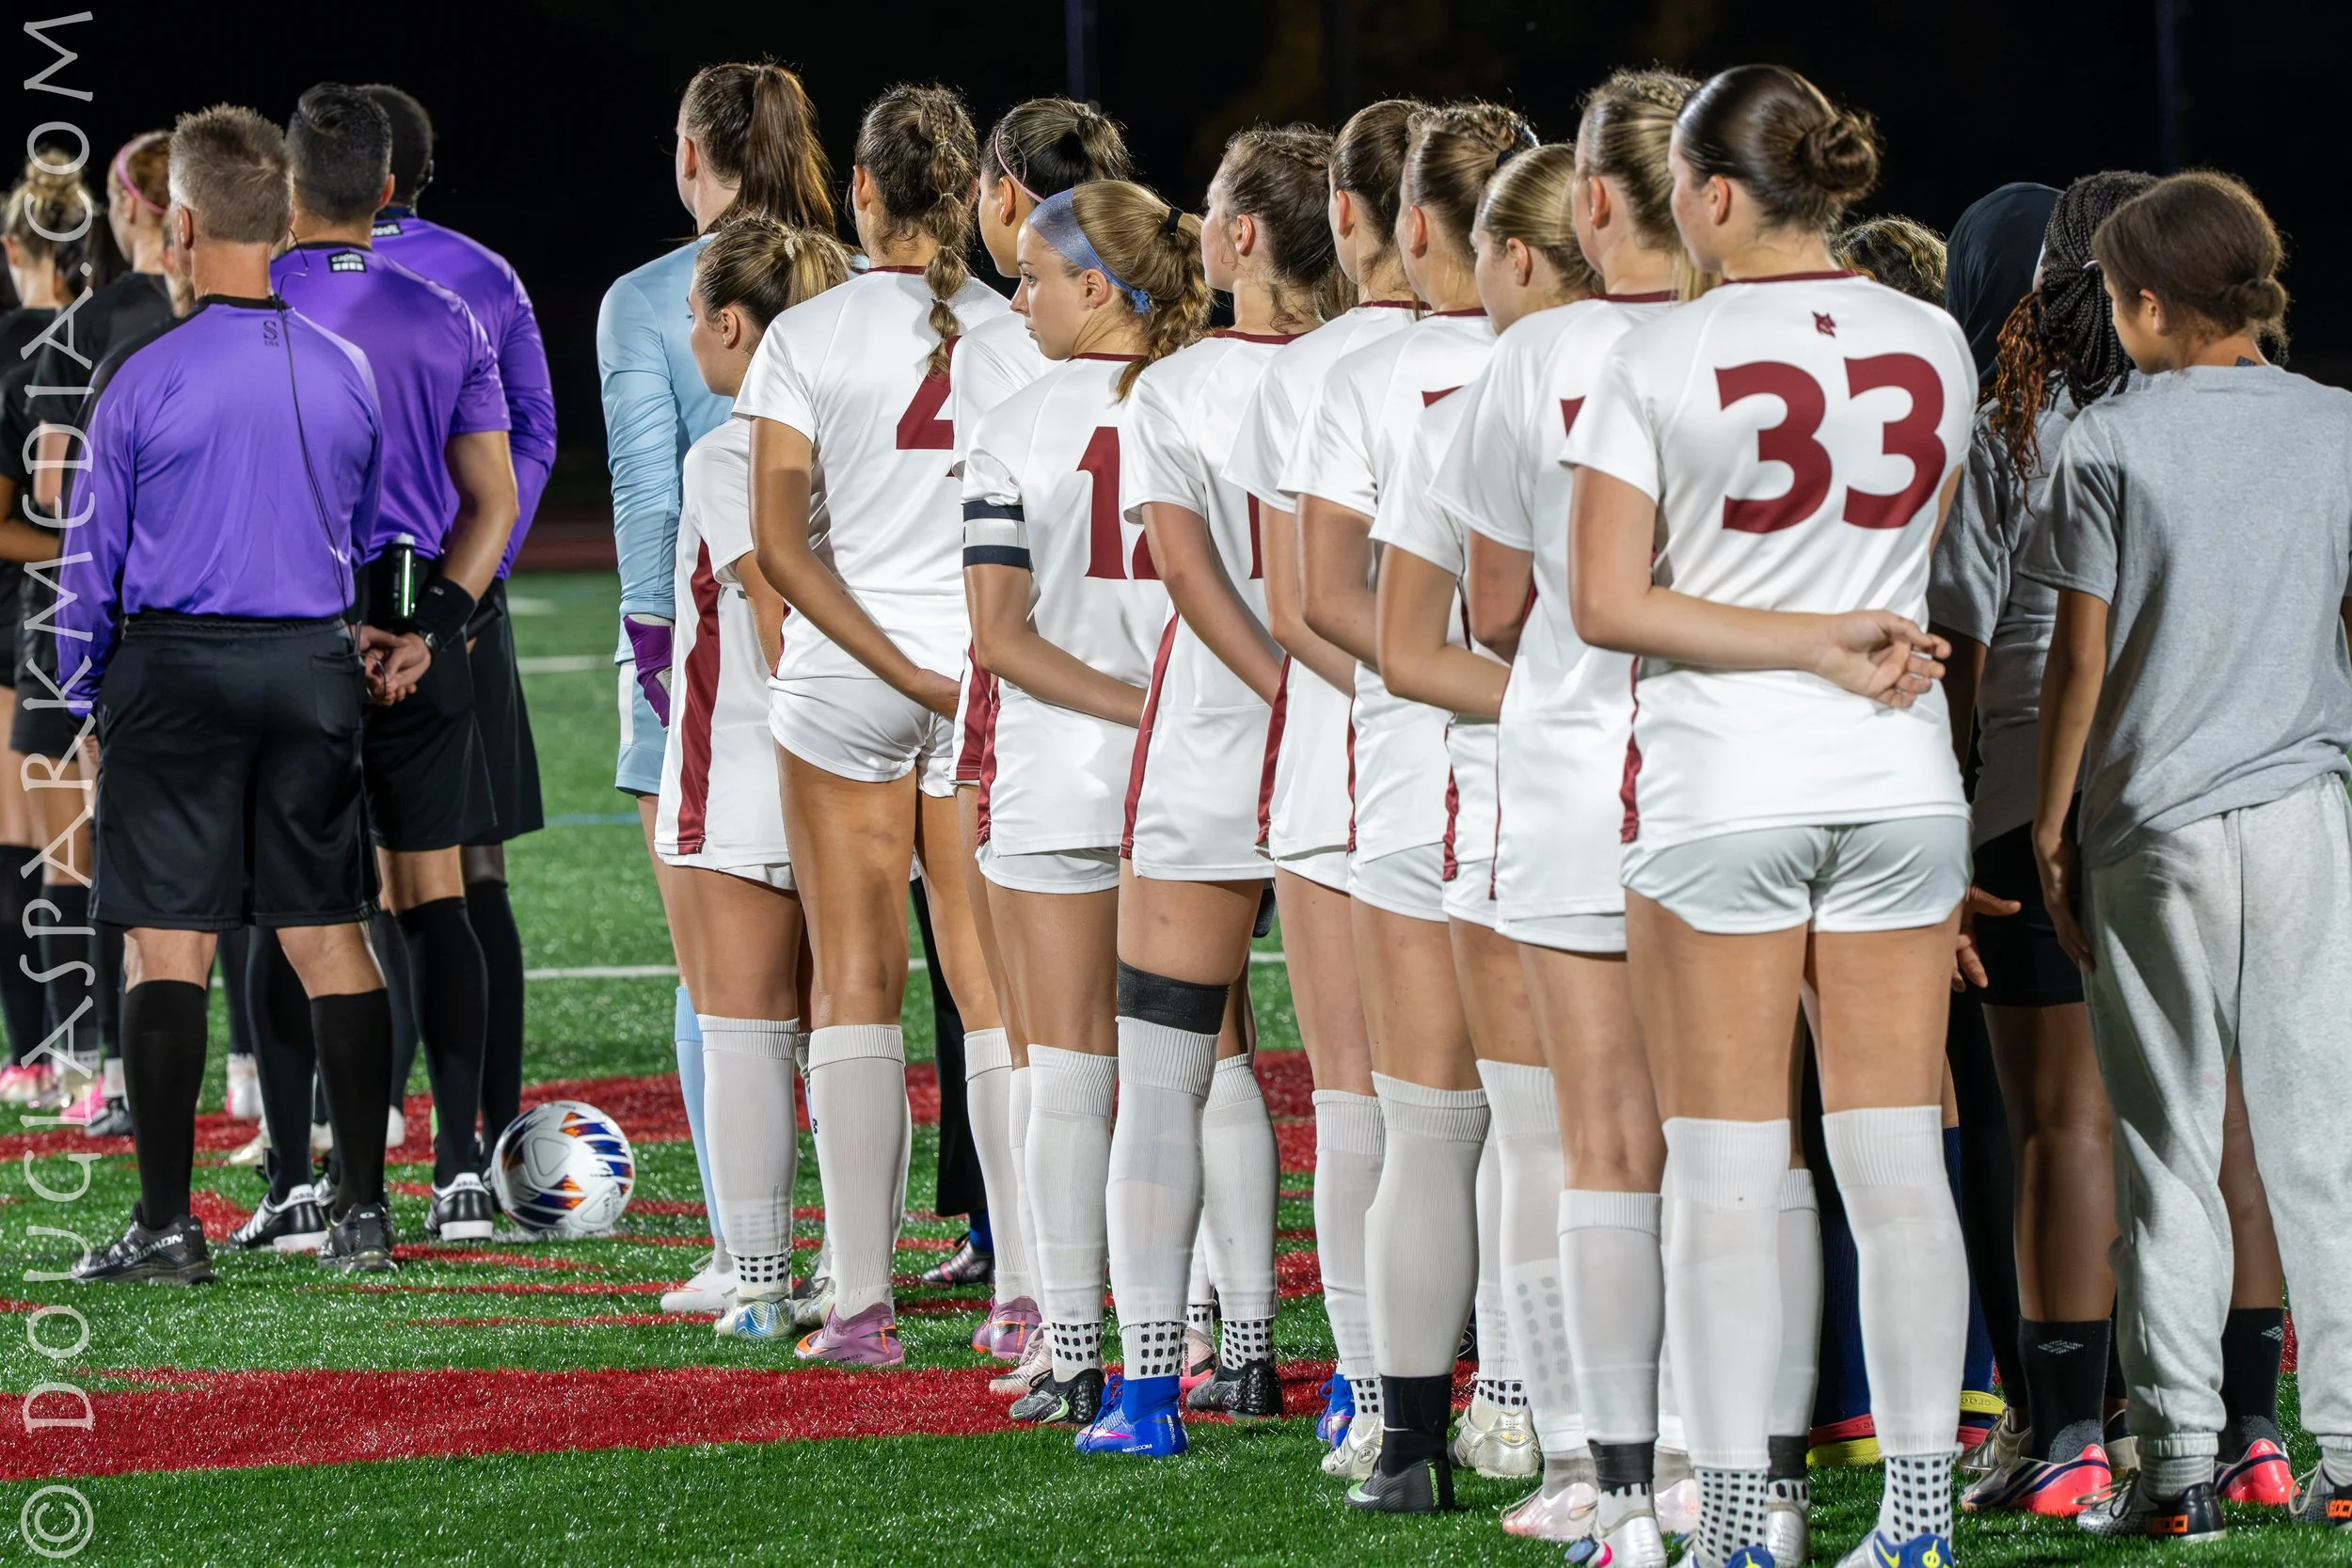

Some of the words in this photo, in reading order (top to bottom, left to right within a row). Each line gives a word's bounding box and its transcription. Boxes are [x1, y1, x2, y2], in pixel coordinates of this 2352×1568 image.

[1715, 353, 1947, 533] 33
[122, 1233, 183, 1268] SALOMON
[1961, 1396, 1992, 1408] CROC
